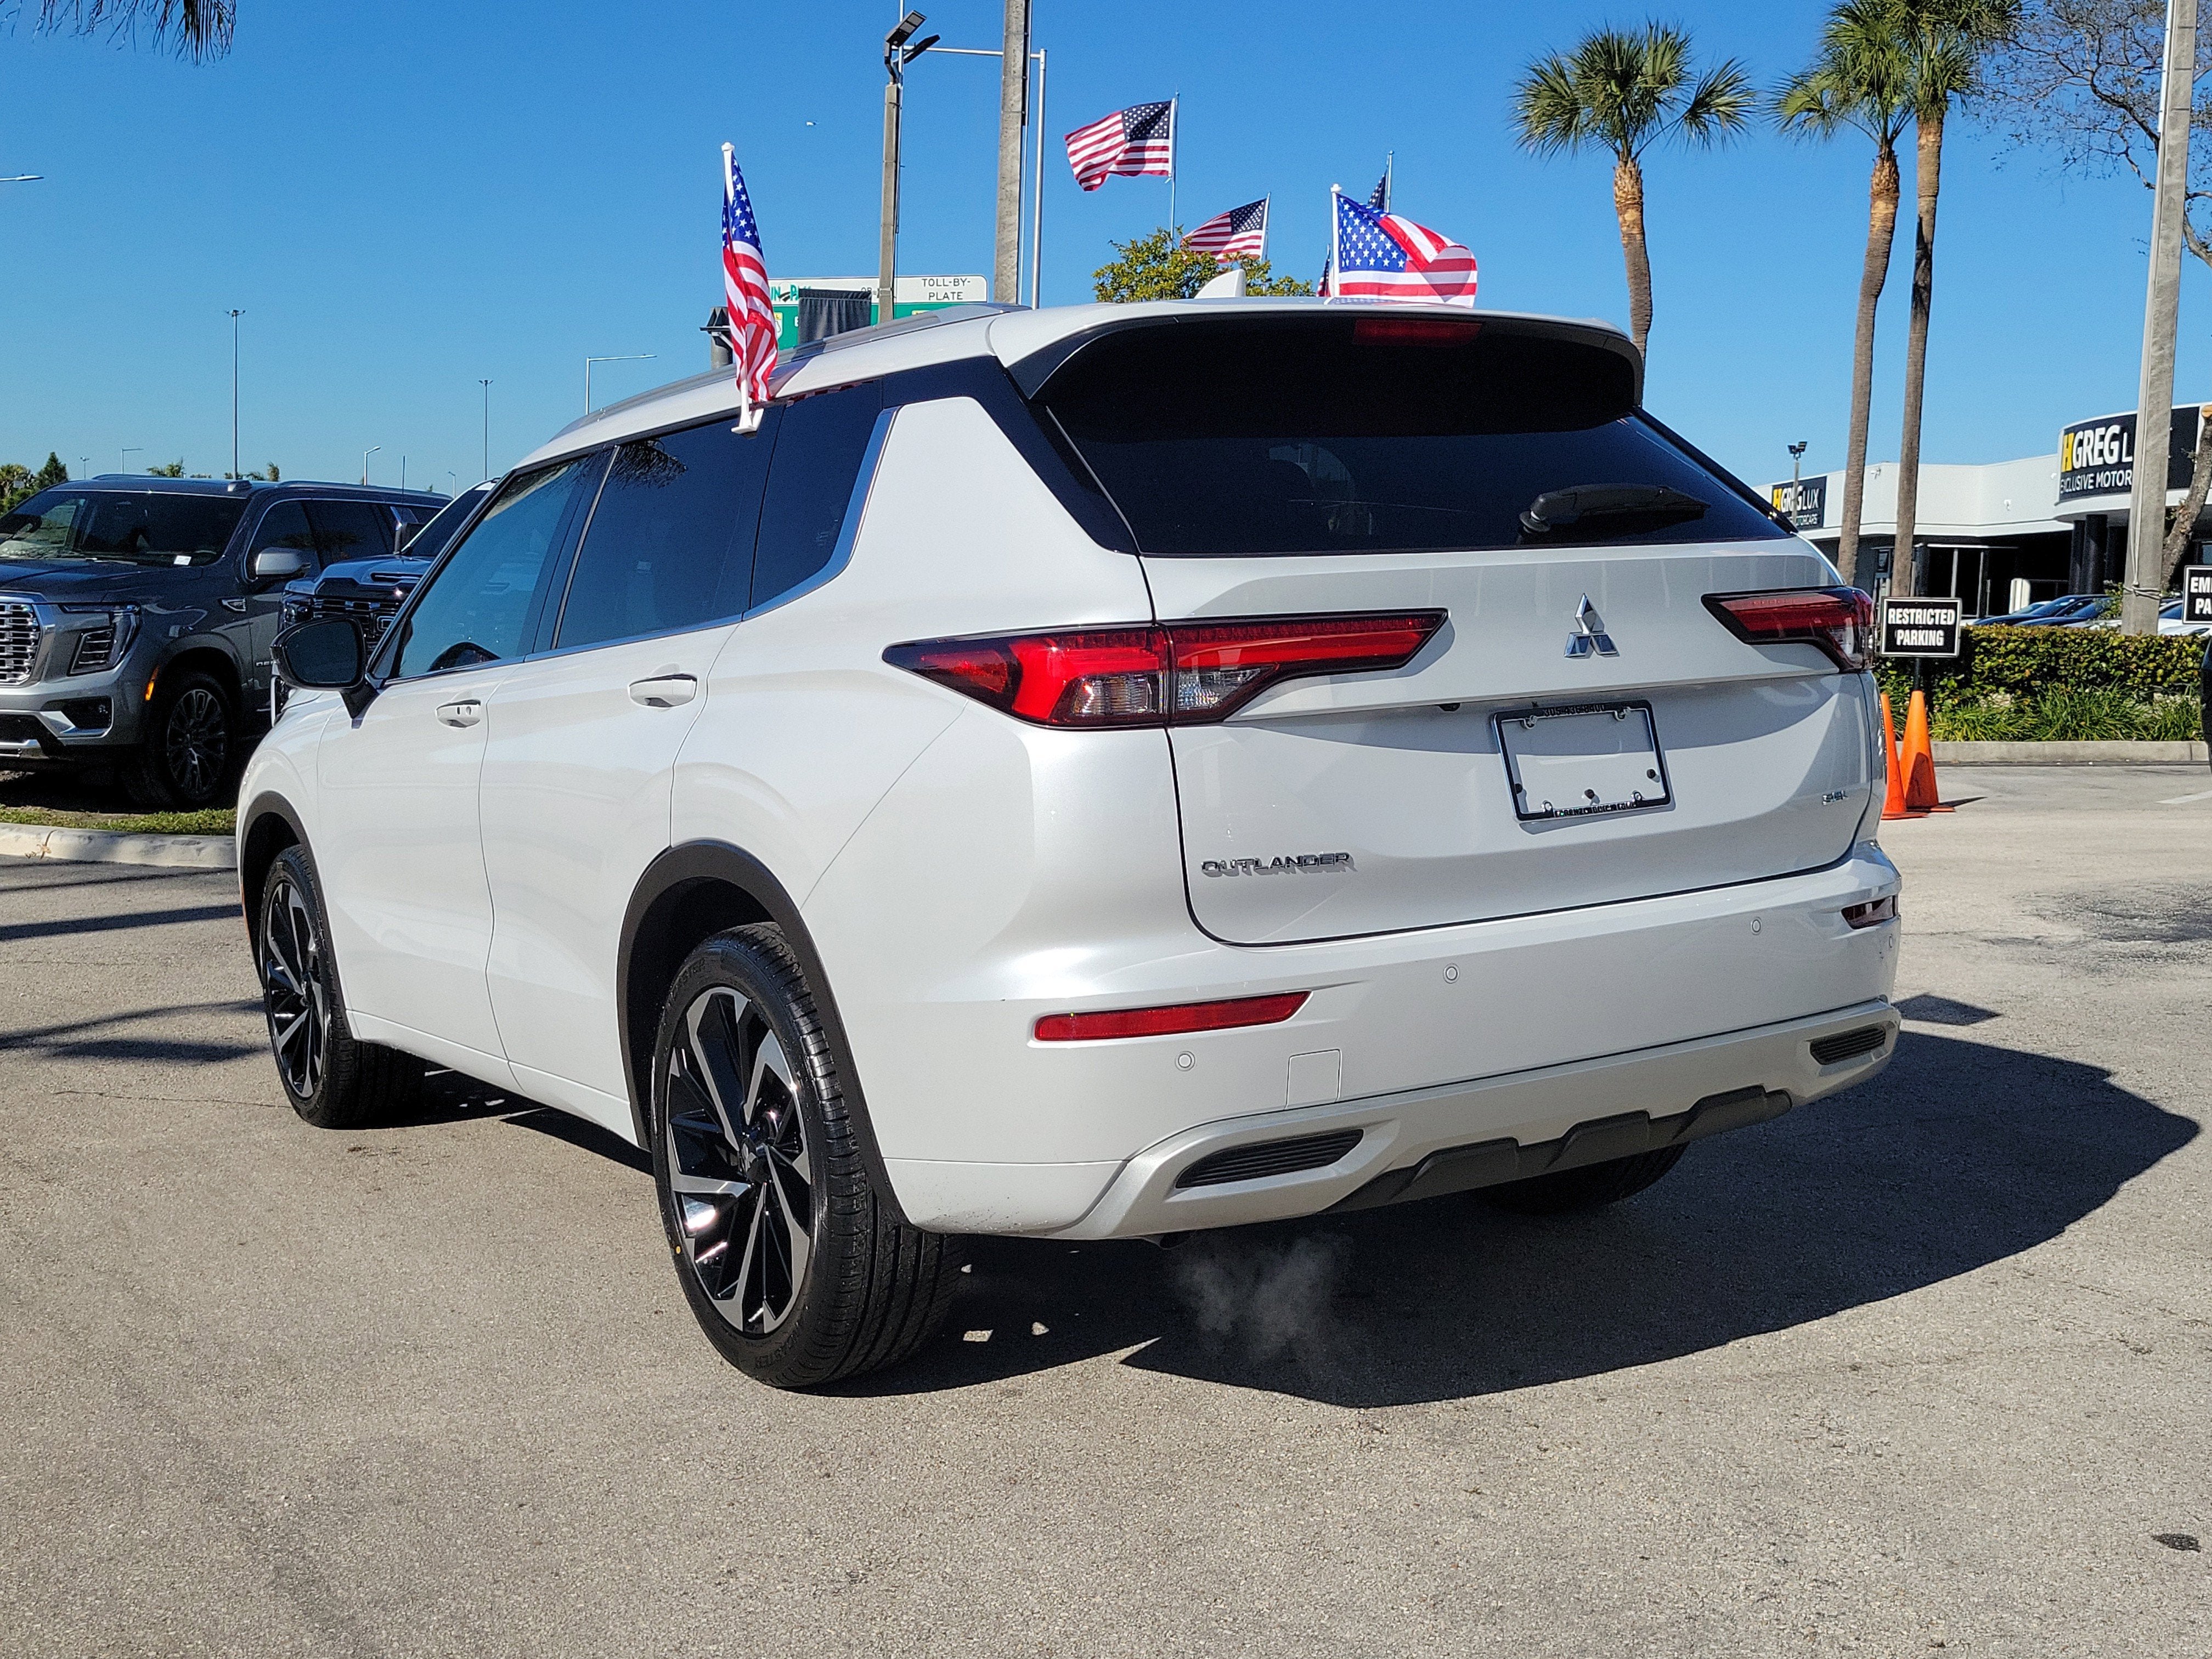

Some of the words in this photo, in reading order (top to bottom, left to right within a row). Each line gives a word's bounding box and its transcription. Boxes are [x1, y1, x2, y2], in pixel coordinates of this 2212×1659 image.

[922, 278, 971, 287] TOLL-BY-
[928, 291, 963, 301] PLATE
[2096, 469, 2133, 488] MOTOR
[2190, 577, 2212, 593] EM
[1888, 608, 1955, 625] RESTRICTED
[1896, 629, 1944, 646] PARKING
[1201, 852, 1351, 871] OUTLANDER
